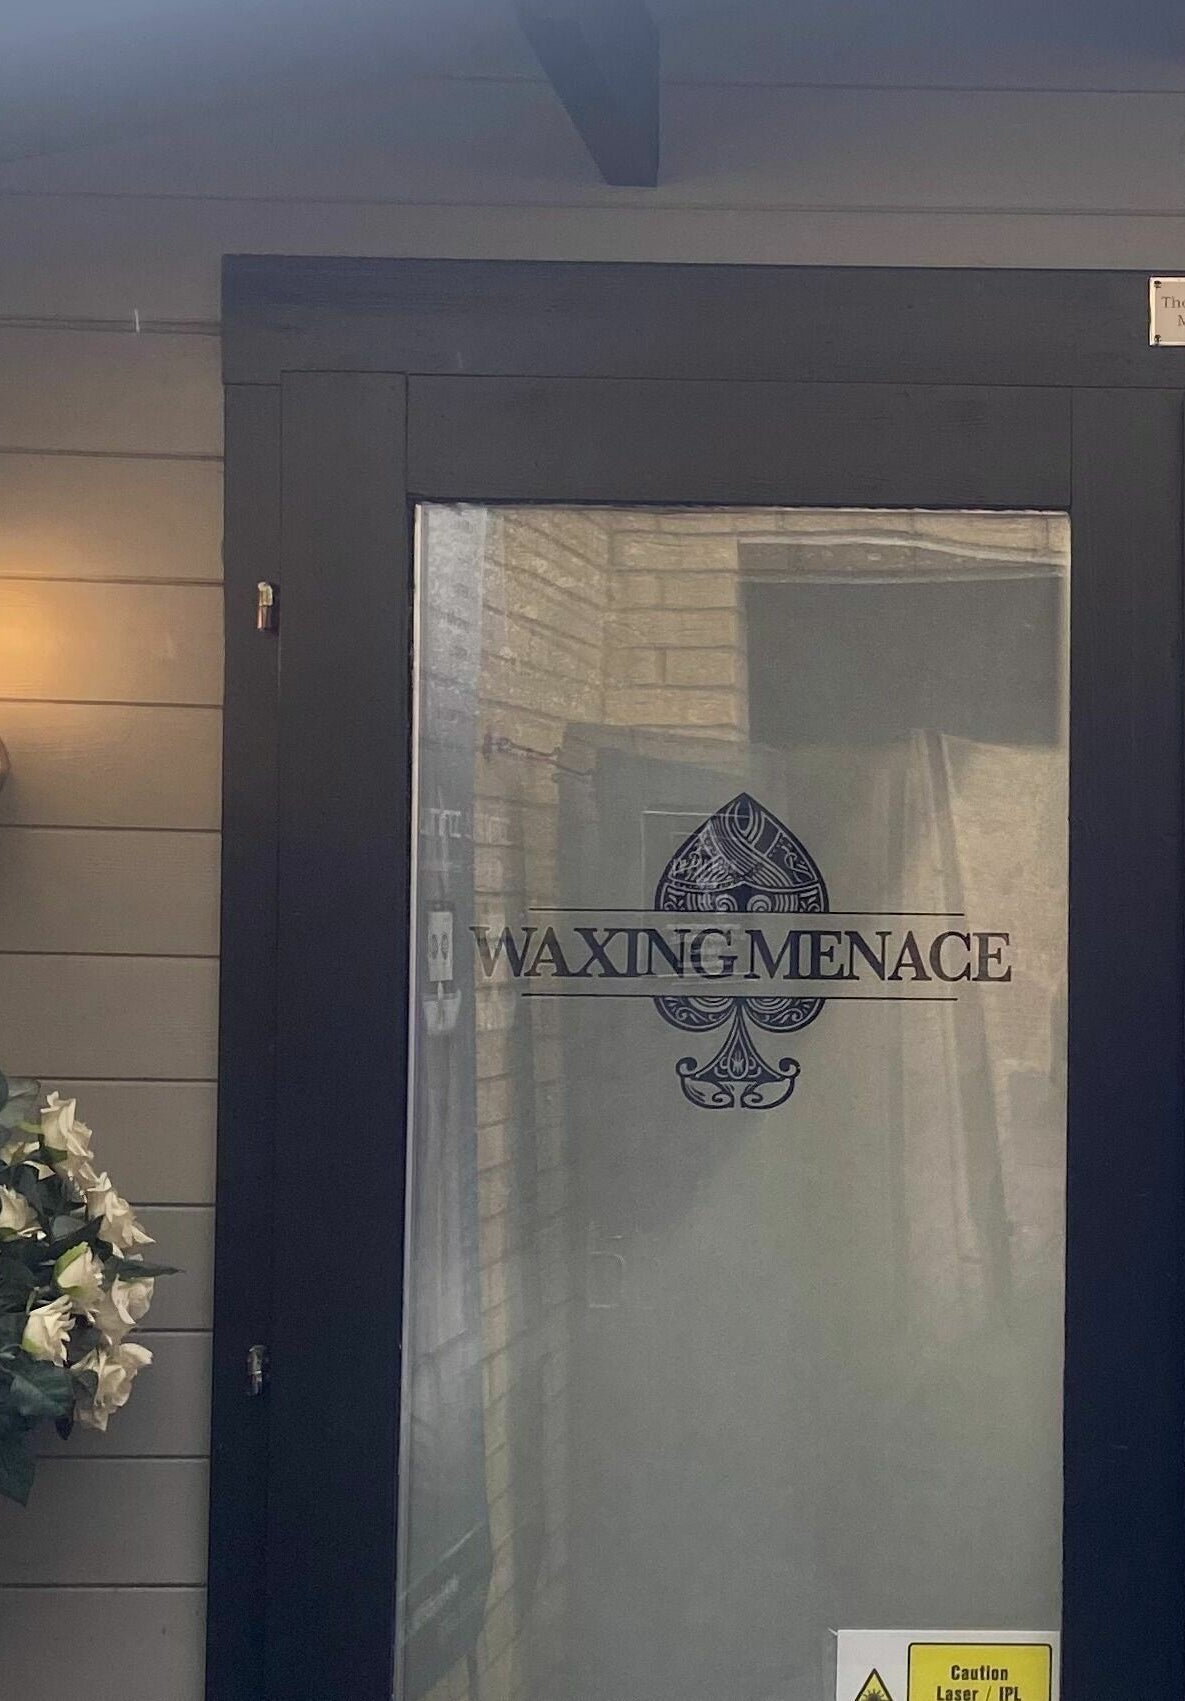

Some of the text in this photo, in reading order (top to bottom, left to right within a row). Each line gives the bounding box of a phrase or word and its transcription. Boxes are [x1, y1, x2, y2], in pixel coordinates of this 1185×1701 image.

[951, 1665, 1008, 1681] Caution
[936, 1685, 979, 1701] Laser
[999, 1686, 1022, 1701] IPL
